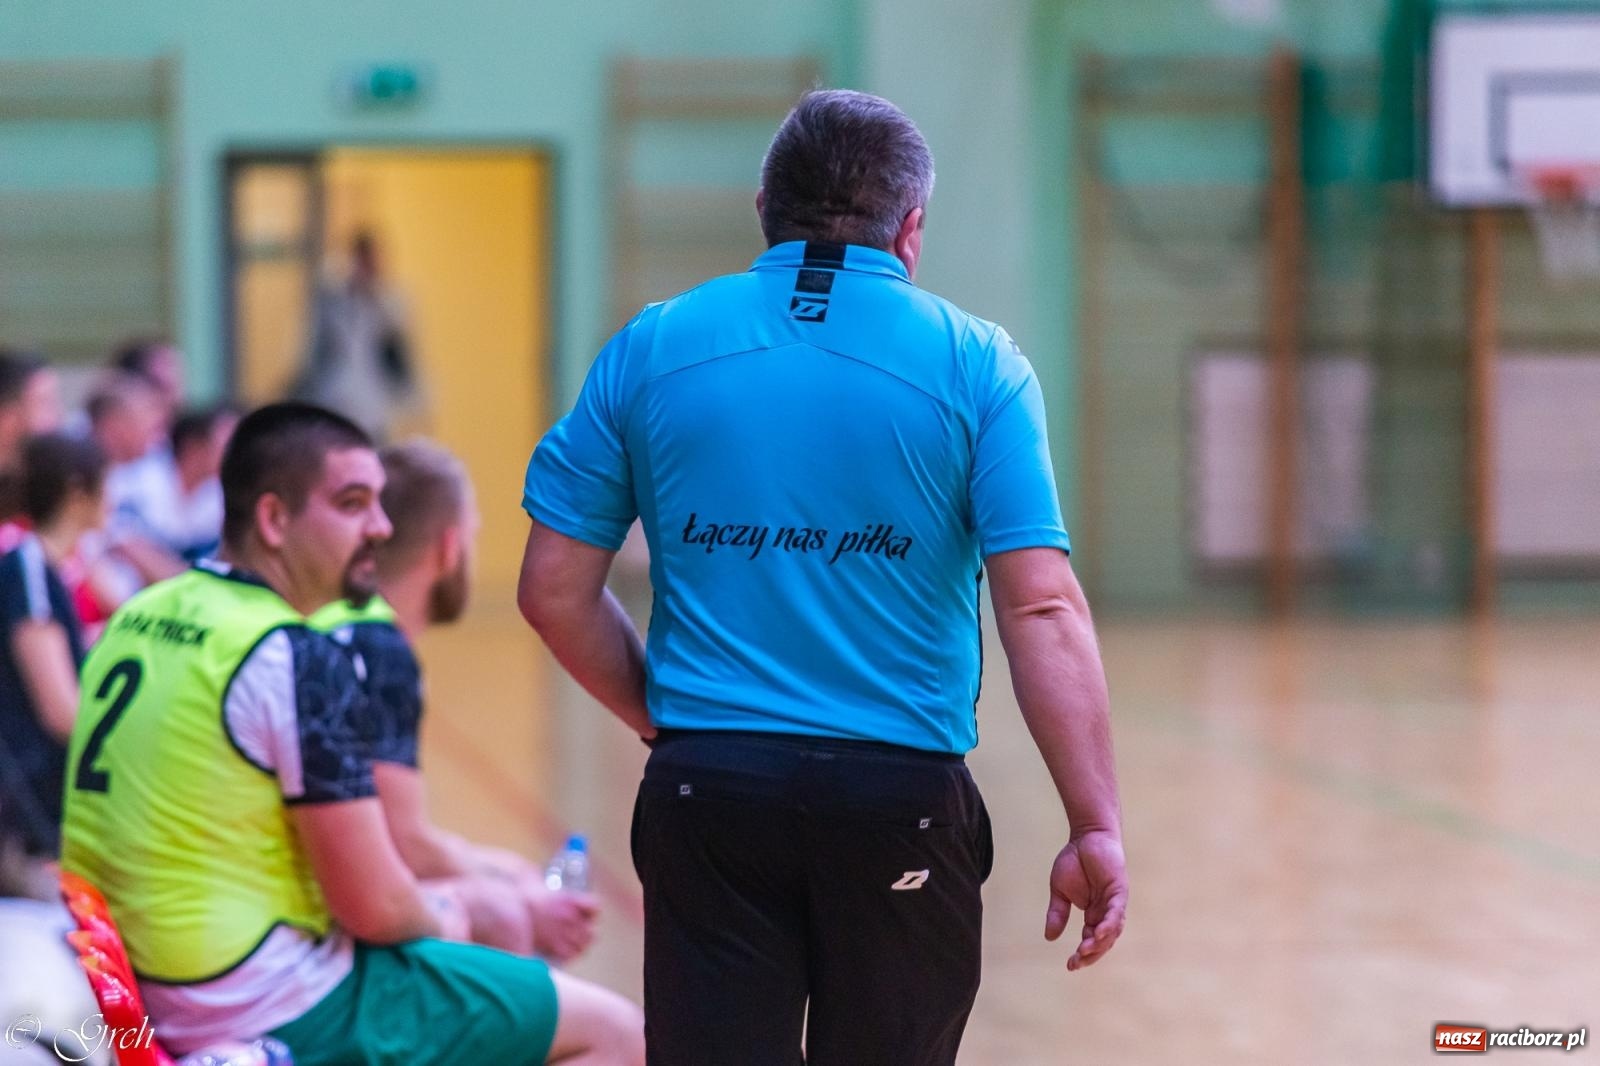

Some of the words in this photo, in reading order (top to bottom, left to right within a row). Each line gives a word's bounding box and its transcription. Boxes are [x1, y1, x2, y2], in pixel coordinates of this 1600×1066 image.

[682, 512, 769, 561] Łączy
[773, 526, 828, 553] nas
[828, 524, 914, 566] piłka
[75, 658, 143, 794] 2
